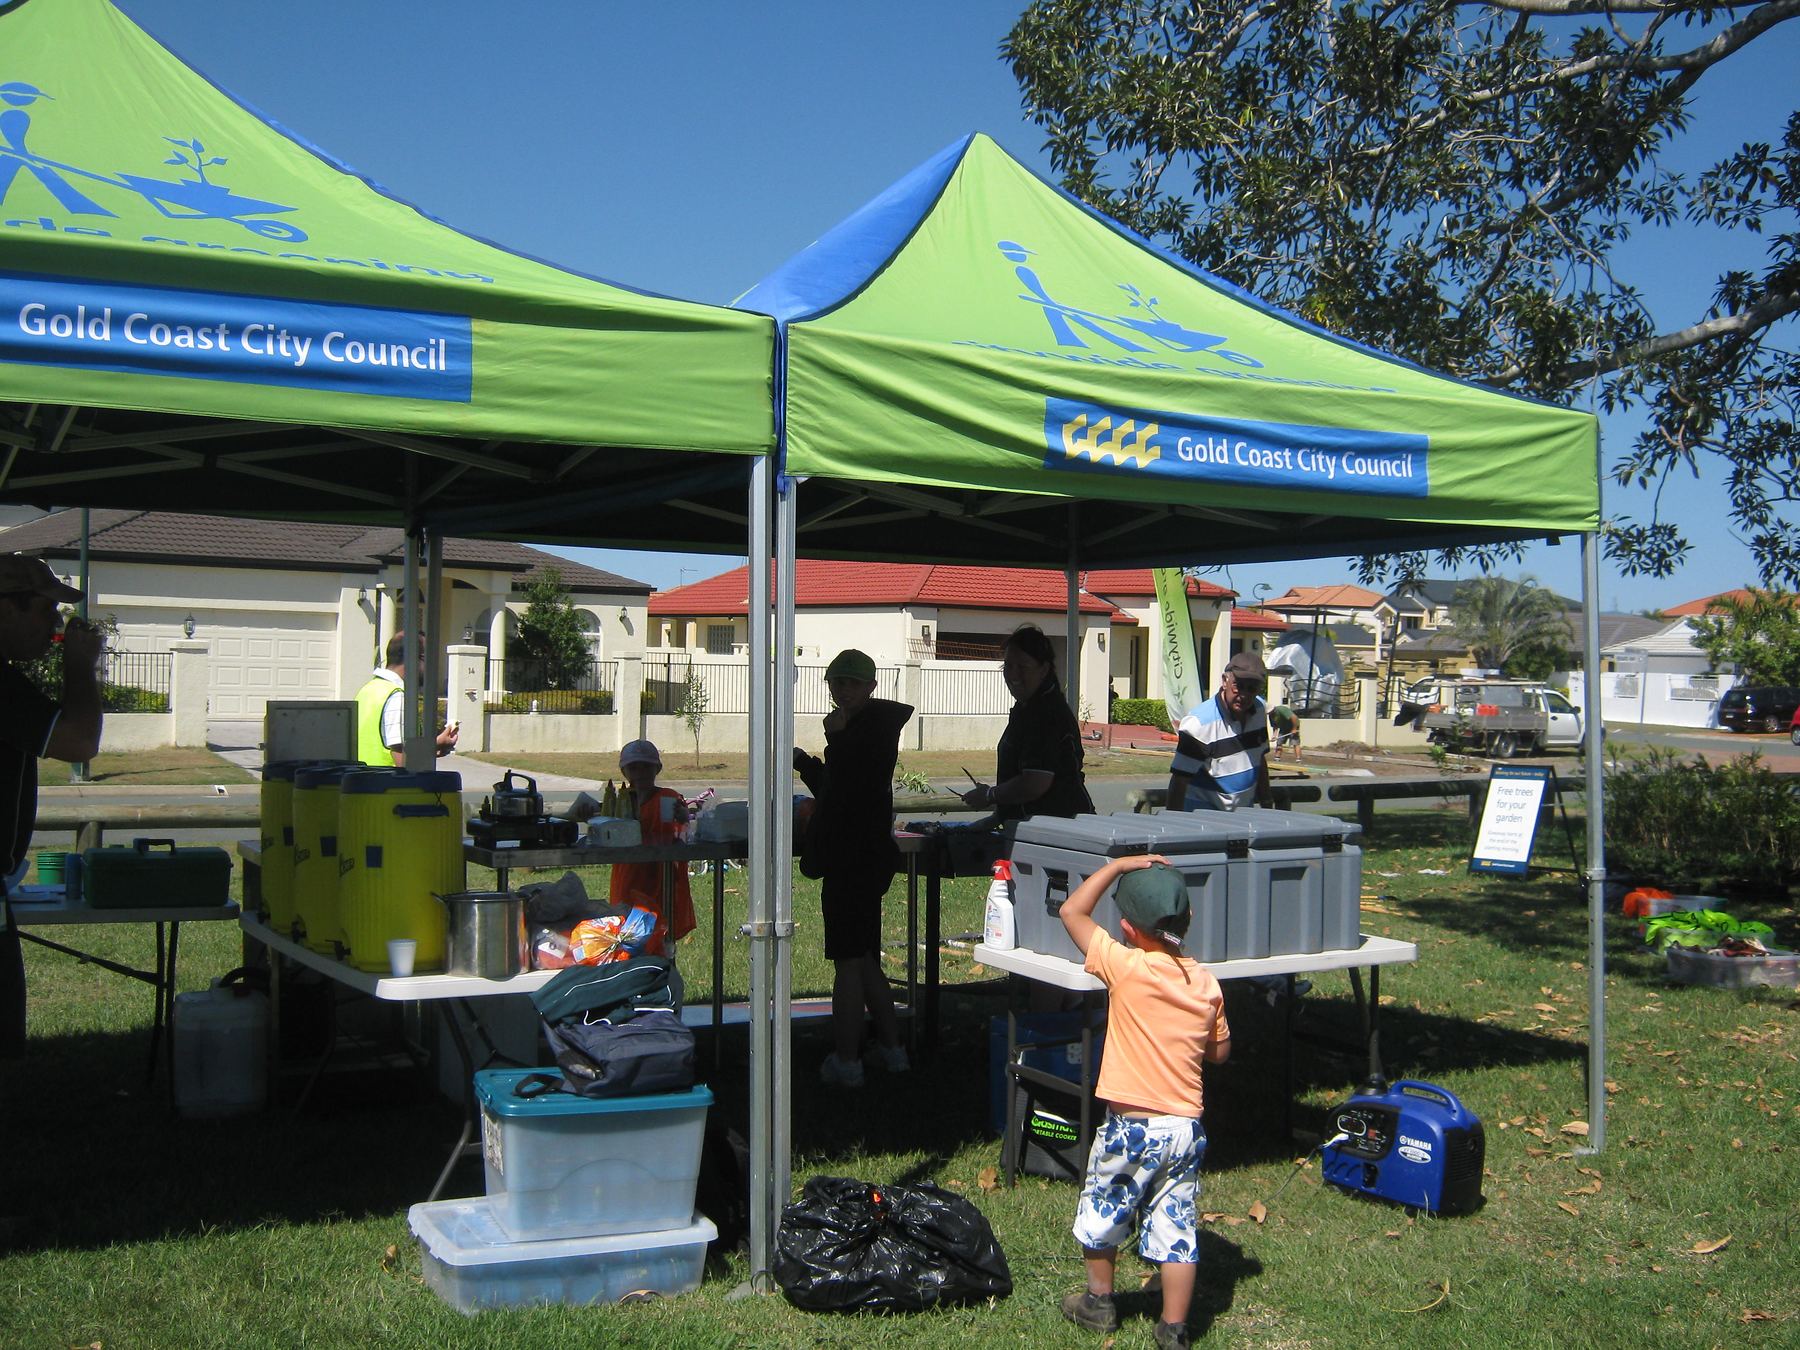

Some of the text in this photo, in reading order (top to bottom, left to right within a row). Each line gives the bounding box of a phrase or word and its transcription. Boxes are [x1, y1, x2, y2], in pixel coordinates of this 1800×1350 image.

[19, 303, 446, 371] Gold Coast City Council
[1178, 436, 1413, 480] Gold Coast City Council
[1497, 786, 1534, 797] Free trees
[1497, 799, 1526, 811] for your
[1496, 813, 1522, 823] garden
[1406, 1137, 1432, 1151] YAMAHA
